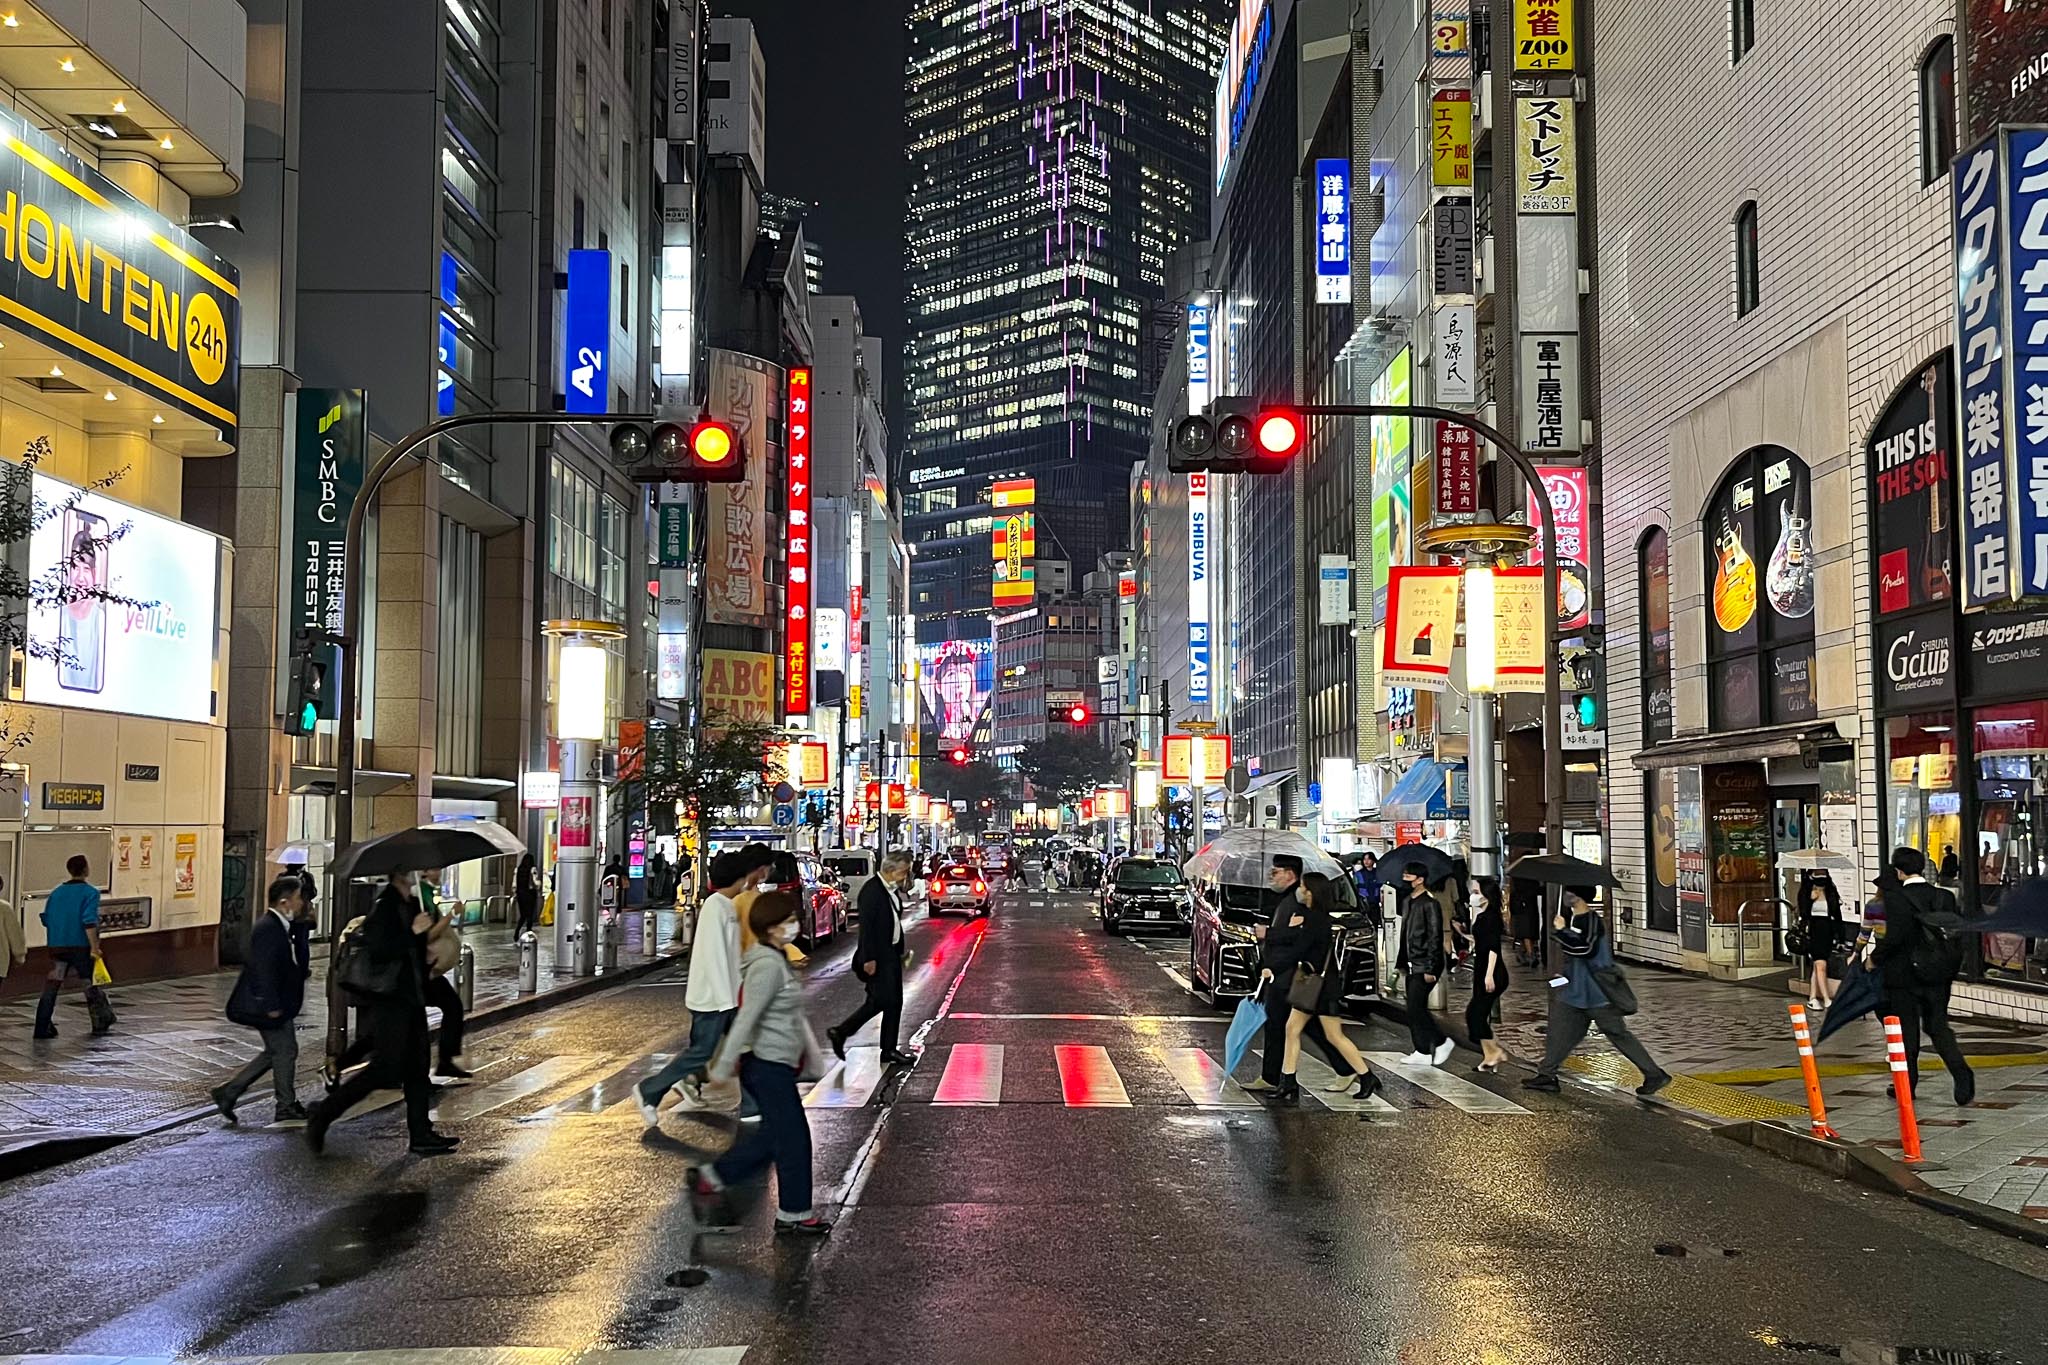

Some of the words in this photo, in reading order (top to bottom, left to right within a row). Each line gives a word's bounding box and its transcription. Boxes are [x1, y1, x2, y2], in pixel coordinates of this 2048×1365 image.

[1527, 0, 1560, 37] 雀
[1520, 40, 1568, 56] ZOO
[1529, 58, 1560, 68] 4F
[674, 77, 690, 115] DOT
[1446, 92, 1460, 101] 6F
[1435, 108, 1454, 161] エステ
[1526, 101, 1564, 192] ストレッチ
[1454, 144, 1469, 180] 麗園
[1321, 175, 1345, 262] 洋服の青山
[1446, 198, 1459, 207] 5F
[1551, 196, 1571, 210] 3F
[1326, 277, 1342, 286] 2F
[1435, 236, 1452, 291] Salon
[1455, 238, 1472, 282] Hair
[1327, 291, 1342, 300] 1F
[189, 316, 225, 365] 24h
[1190, 329, 1207, 379] LABI
[572, 346, 601, 398] A2
[1536, 340, 1563, 448] 富士屋酒店
[1960, 149, 2007, 599] クロサワ楽器店
[1526, 441, 1538, 450] 1F
[1875, 428, 1916, 473] THIS
[1919, 419, 1936, 455] IS
[317, 439, 340, 523] SMBC
[725, 376, 753, 608] カラケ歌広場
[1190, 473, 1206, 496] BI
[1441, 446, 1453, 510] 韓国家庭料理
[1459, 450, 1471, 506] 炭火焼肉
[1876, 464, 1912, 505] THE
[1192, 512, 1204, 581] SHIBUYA
[305, 540, 320, 628] PRESTI
[325, 540, 345, 645] 三井住友銀
[705, 658, 768, 698] ABC
[1190, 646, 1208, 700] LABI
